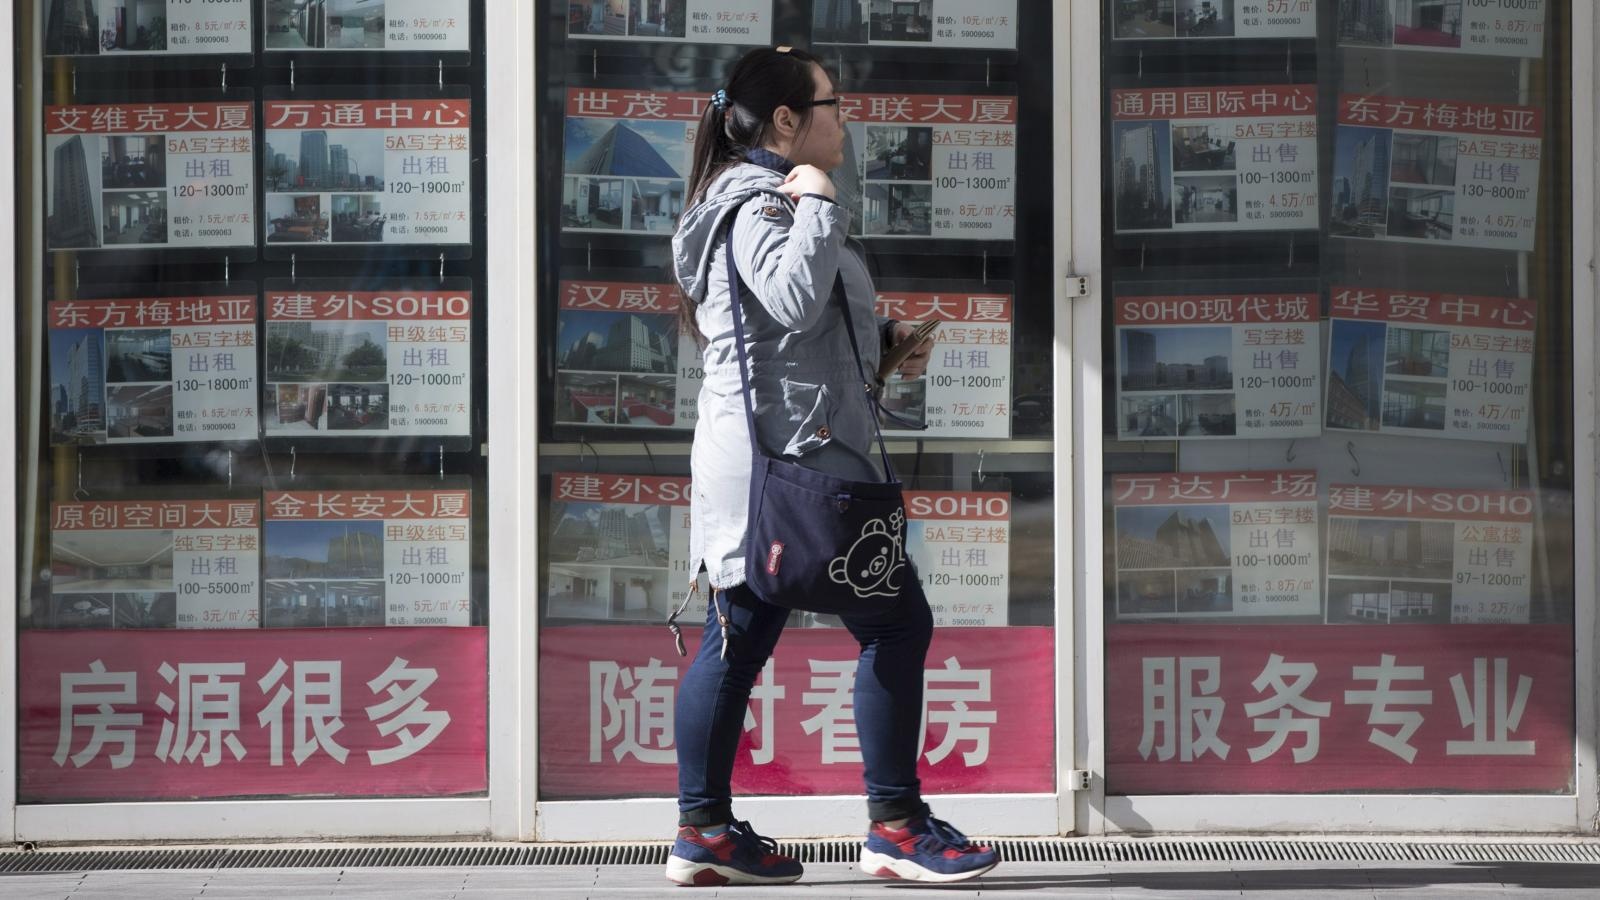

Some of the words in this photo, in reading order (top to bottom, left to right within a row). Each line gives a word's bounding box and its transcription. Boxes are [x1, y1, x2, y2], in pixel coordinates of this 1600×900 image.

[1114, 88, 1312, 116] 通用国际中心
[51, 105, 250, 132] 艾维克大厦
[271, 102, 467, 127] 万通中心
[1346, 97, 1536, 133] 东方梅地亚
[932, 129, 1013, 146] 5A写字楼
[1234, 121, 1316, 138] 5A写字楼
[168, 136, 250, 153] 5A写字楼
[385, 134, 467, 150] 5A写字楼
[1458, 140, 1540, 160] 5A写字楼
[948, 151, 995, 170] 出租
[1252, 143, 1299, 163] 出售
[185, 158, 233, 178] 出租
[402, 155, 449, 175] 出租
[1472, 161, 1520, 183] 出售
[272, 294, 469, 319] 建外SOHO
[567, 284, 681, 310] 汉威
[54, 299, 254, 327] 东方梅地亚
[1123, 296, 1310, 322] SOHO现代城
[1334, 290, 1534, 326] 华贸中心
[172, 330, 254, 346] 5A写字楼
[388, 326, 467, 342] 甲级纯写
[1244, 328, 1305, 344] 写字楼
[1451, 334, 1534, 353] 5A写字楼
[189, 353, 236, 372] 出租
[403, 347, 450, 367] 出租
[943, 350, 990, 369] 出租
[1253, 350, 1300, 370] 出售
[1467, 358, 1515, 380] 出售
[1115, 473, 1317, 500] 万达广场
[270, 493, 467, 518] 金长安大厦
[911, 496, 1008, 516] SOHO
[1328, 486, 1533, 516] 建外SOHO
[54, 503, 257, 529] 原创空间大厦
[1232, 507, 1315, 524] 5A写字楼
[175, 534, 257, 551] 纯写字楼
[387, 525, 466, 541] 甲级纯写
[925, 527, 1008, 543] 5A写字楼
[1249, 528, 1297, 548] 出售
[191, 556, 238, 576] 出租
[402, 547, 449, 566] 出租
[941, 548, 988, 567] 出租
[1467, 547, 1515, 568] 出售
[935, 617, 985, 626] 话：59009063
[51, 656, 452, 770] 房源很多
[1137, 652, 1536, 765] 服务专业
